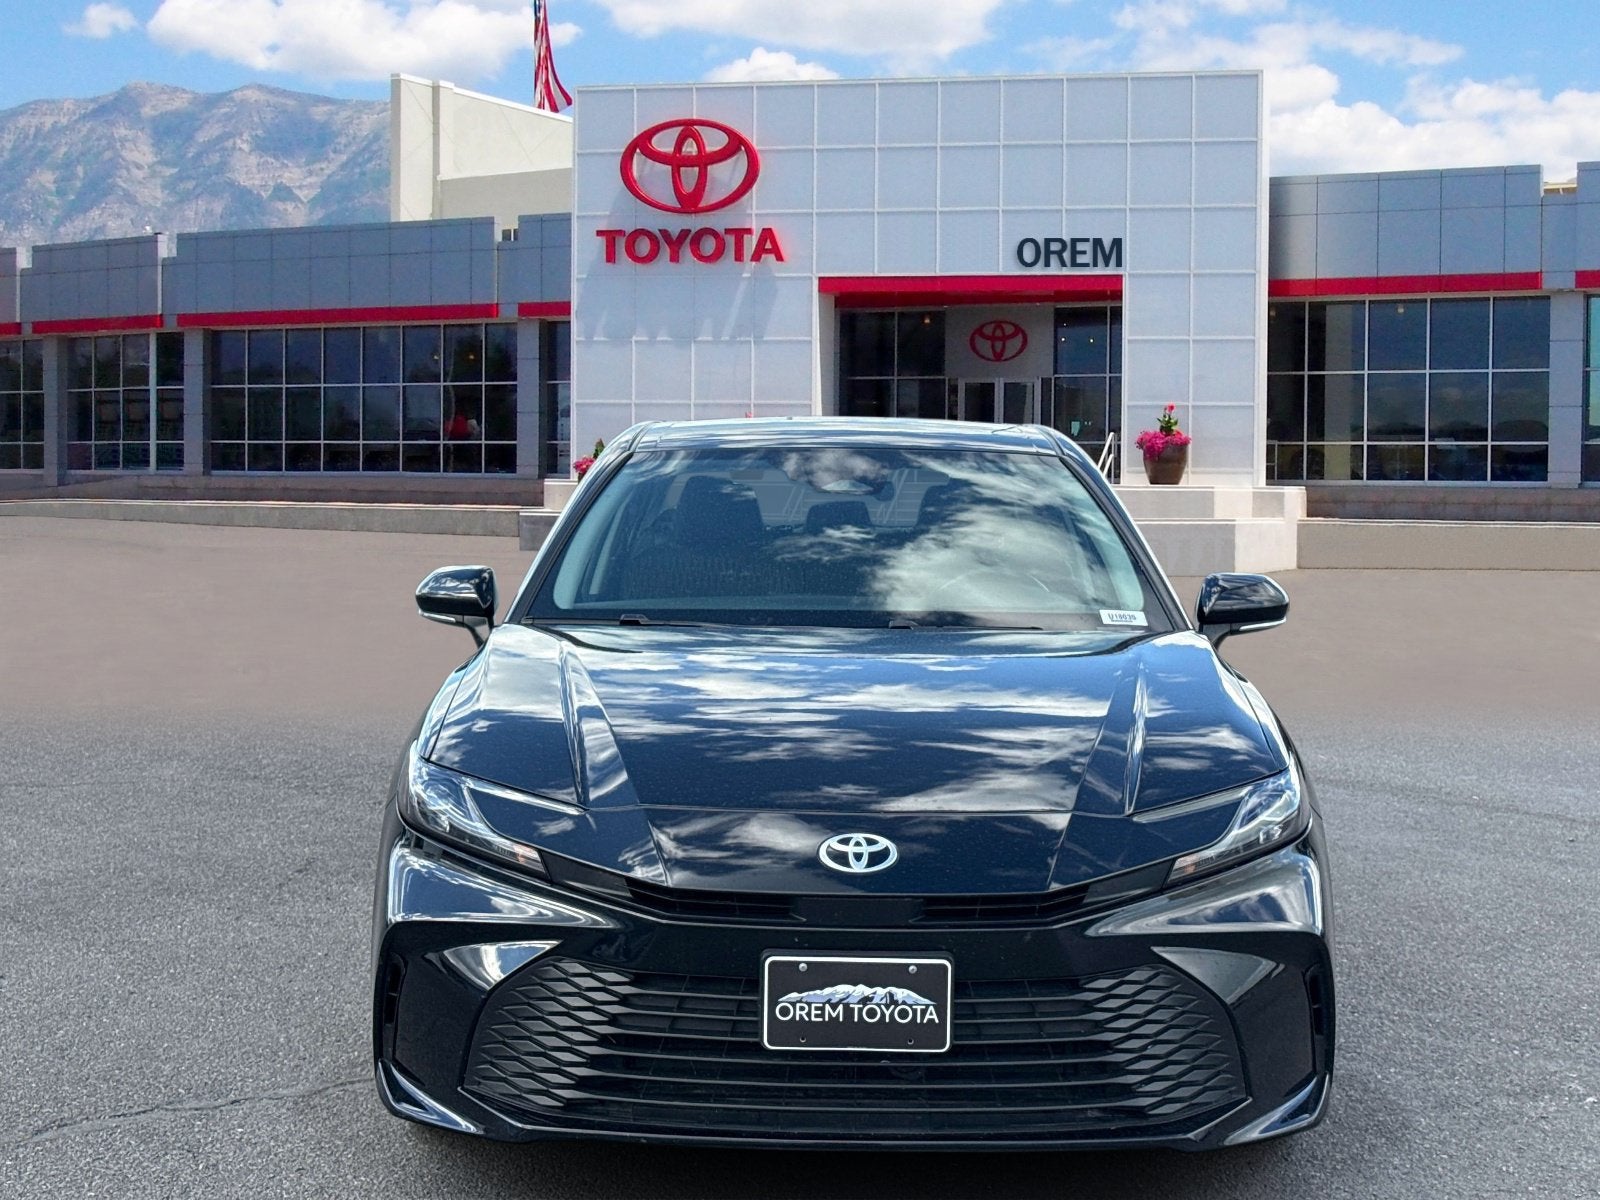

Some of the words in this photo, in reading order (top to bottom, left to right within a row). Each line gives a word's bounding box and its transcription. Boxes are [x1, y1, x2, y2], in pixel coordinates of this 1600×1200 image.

[596, 227, 785, 264] TOYOTA
[1017, 237, 1123, 268] OREM
[775, 1003, 843, 1022] OREM
[850, 1003, 939, 1024] TOYOTA
